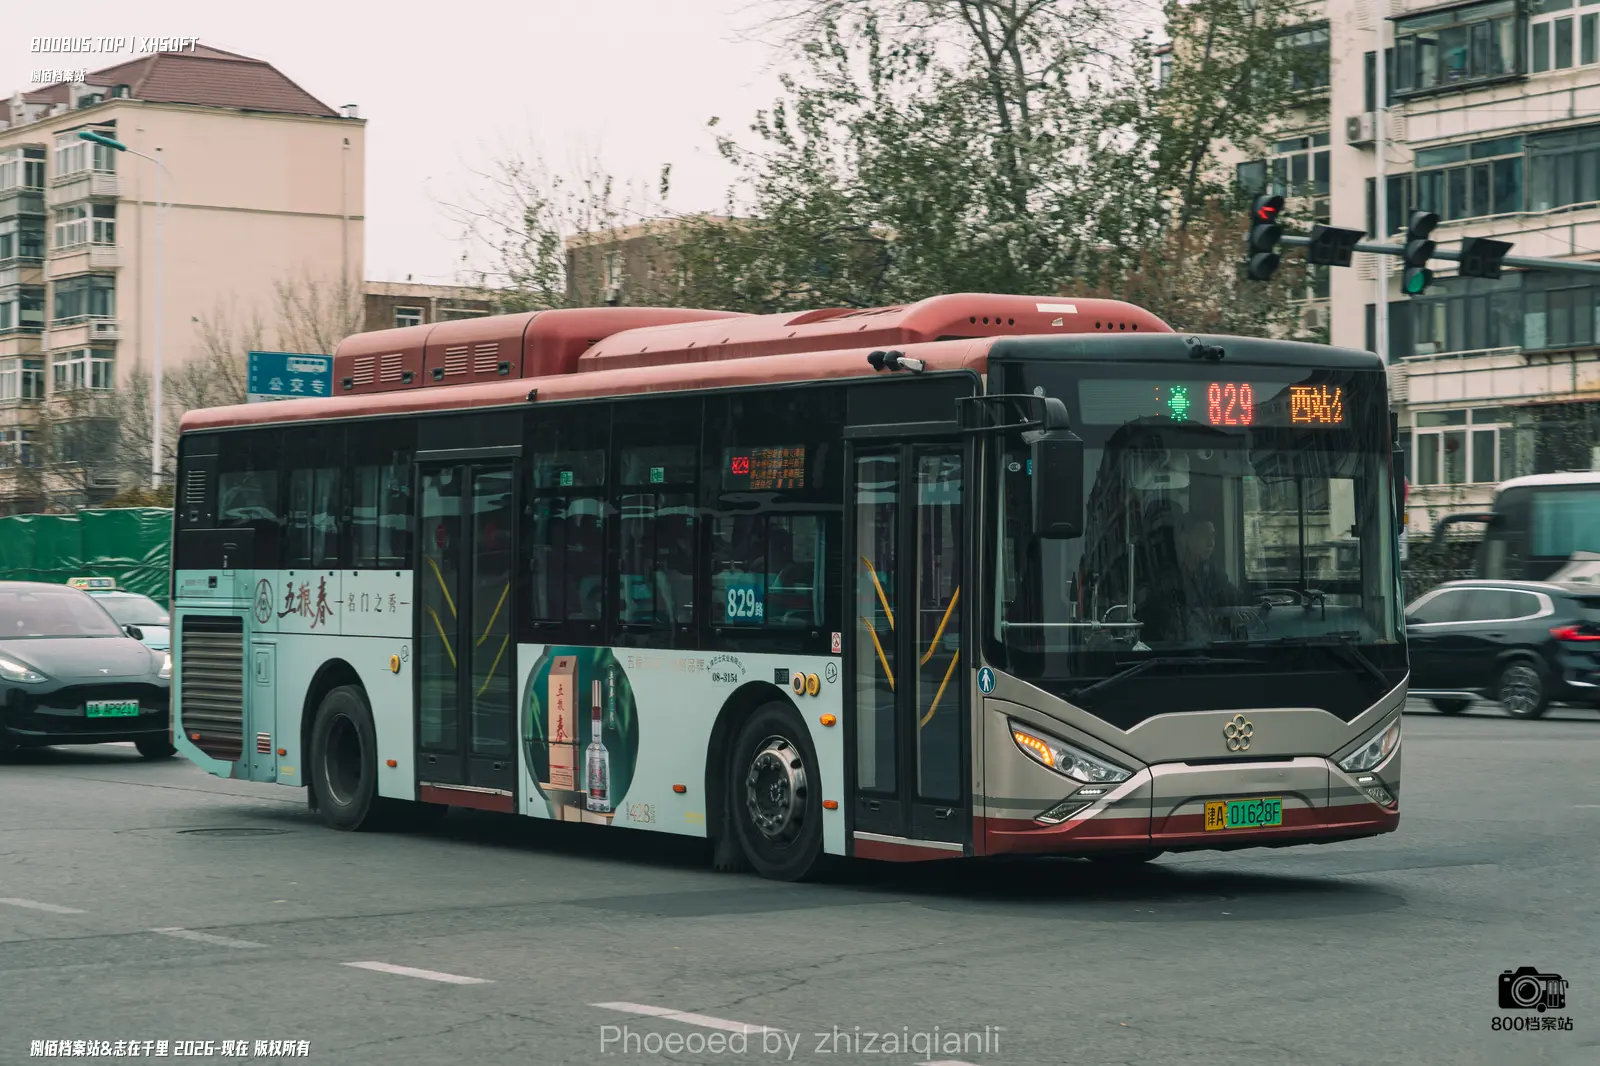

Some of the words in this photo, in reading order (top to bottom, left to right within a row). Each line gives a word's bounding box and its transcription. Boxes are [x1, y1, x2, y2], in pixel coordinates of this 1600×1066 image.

[1208, 383, 1252, 425] 829
[277, 576, 333, 629] 五粮春
[712, 672, 738, 683] 08-3154
[1231, 802, 1281, 825] 01628F
